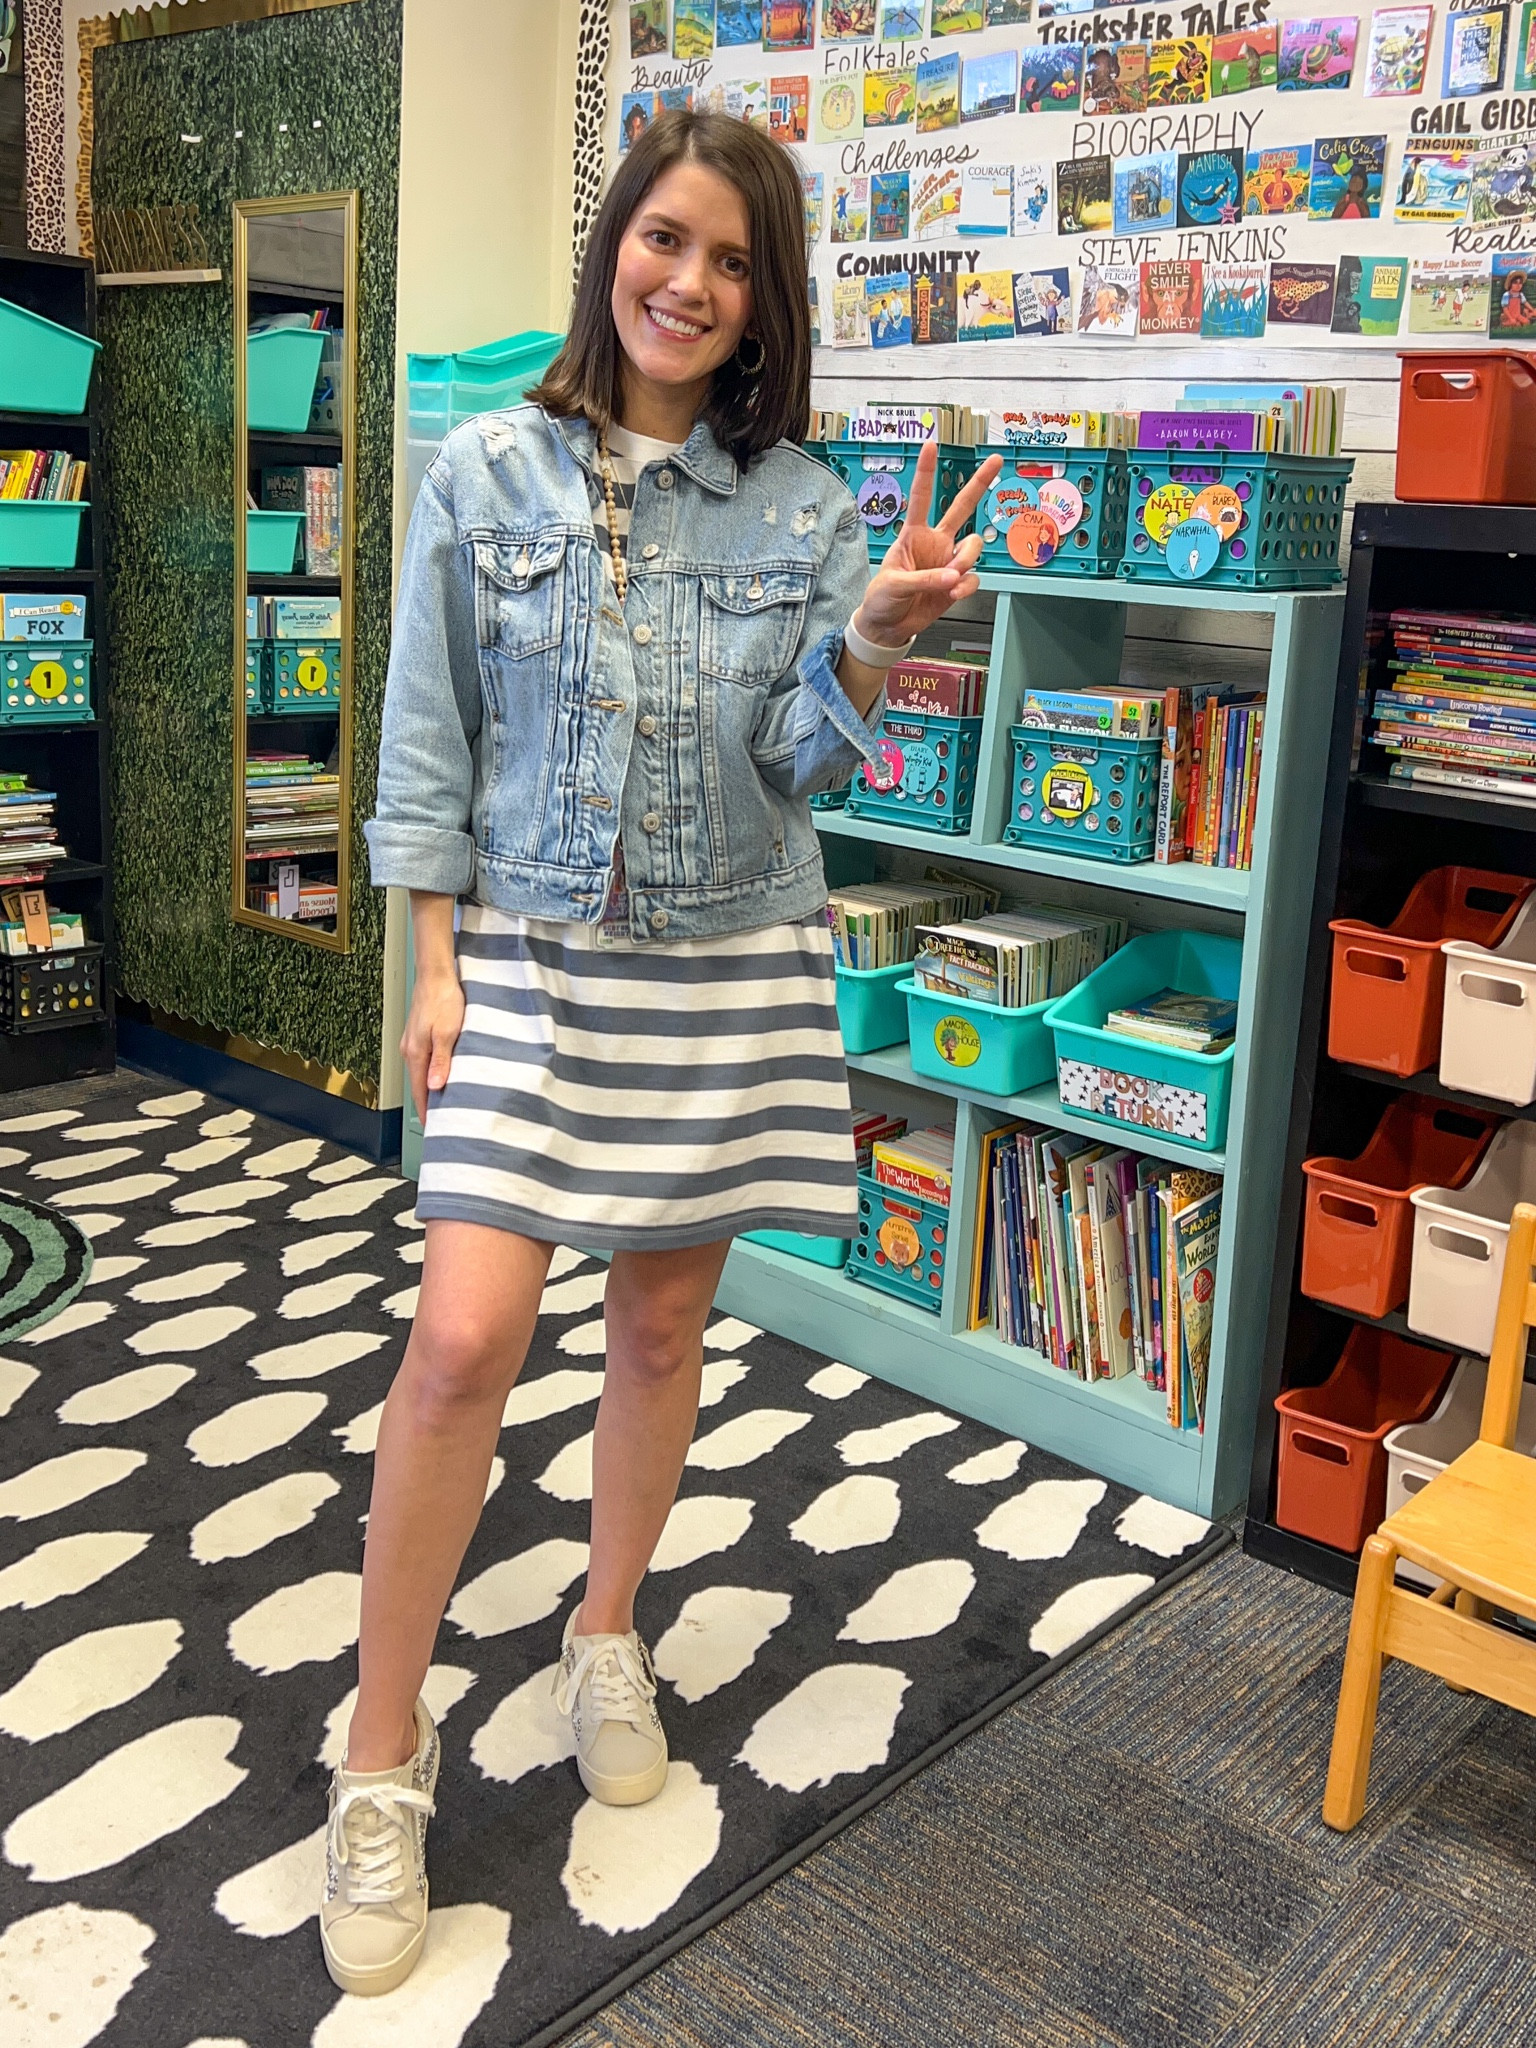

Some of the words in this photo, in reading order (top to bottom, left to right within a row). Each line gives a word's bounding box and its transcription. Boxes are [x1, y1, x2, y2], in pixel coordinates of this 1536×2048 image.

[1466, 29, 1488, 39] MISS
[631, 58, 713, 93] Beauty
[921, 62, 955, 79] TREASURE
[830, 76, 847, 84] EMPTY
[1410, 102, 1472, 133] GAIL
[1072, 109, 1264, 161] BIOGRAPHY
[1319, 139, 1347, 160] Celia
[1350, 138, 1377, 158] Cruz
[1406, 139, 1474, 151] PENGUINS
[1479, 136, 1513, 151] GIANT
[841, 139, 980, 175] Challenges
[1188, 152, 1232, 176] MANFISH
[968, 166, 1010, 176] COURAGE
[917, 169, 960, 210] COASTER
[1498, 218, 1522, 227] GIBBONS
[1079, 237, 1162, 267] STEVE
[1171, 225, 1288, 264] JENKINS
[836, 250, 981, 279] COMMUNITY
[1149, 263, 1191, 275] NEVER
[1422, 261, 1443, 270] Happy
[1444, 260, 1460, 268] Like
[1460, 259, 1483, 268] Soccer
[1104, 273, 1138, 281] FLIGHT
[1211, 268, 1222, 279] See
[1374, 275, 1399, 285] DADS
[1151, 276, 1190, 289] SMILE
[1162, 290, 1176, 302] AT
[1165, 304, 1174, 316] A
[1141, 318, 1195, 330] MONKEY
[1003, 412, 1027, 425] Ready,
[1041, 412, 1070, 427] Freddy!
[858, 419, 883, 437] BAD
[898, 420, 935, 439] KITTY
[1160, 429, 1189, 439] AARON
[1192, 428, 1233, 439] BLABEY
[1004, 428, 1068, 445] Super-Secret
[871, 475, 884, 484] BAD
[996, 488, 1028, 503] Ready,
[1158, 489, 1190, 497] big
[1039, 492, 1075, 519] RAINBOW
[1151, 498, 1195, 509] NATE
[1023, 514, 1043, 524] CAM
[1175, 526, 1211, 537] NARWHAL
[38, 606, 58, 614] Read!
[27, 620, 64, 635] FOX
[43, 671, 51, 689] 1
[899, 674, 940, 691] DIARY
[908, 690, 919, 703] of
[919, 695, 927, 704] a
[1052, 700, 1072, 708] LAGOON
[1450, 700, 1477, 711] Unicorn
[891, 724, 903, 733] THE
[1508, 724, 1526, 733] RESCUE
[1452, 732, 1474, 742] NANCY
[923, 757, 933, 767] Kid
[1158, 782, 1169, 818] REPORT
[1158, 821, 1167, 845] CARD
[25, 895, 40, 915] E
[946, 937, 966, 947] MAGIC
[934, 941, 954, 953] TREE
[954, 945, 977, 959] HOUSE
[949, 955, 964, 966] FACT
[964, 959, 990, 975] TRACKER
[957, 972, 996, 990] Vikings
[943, 1019, 969, 1032] MAGIC
[957, 1036, 981, 1048] HOUSE
[1099, 1069, 1164, 1102] BOOK
[1090, 1089, 1175, 1132] RETURN
[881, 1163, 895, 1177] The
[894, 1172, 920, 1188] World
[921, 1187, 942, 1200] according
[885, 1221, 915, 1236] Humphrey
[1188, 1210, 1218, 1235] Magic
[891, 1232, 910, 1243] Series
[1092, 1236, 1100, 1268] America
[1187, 1244, 1216, 1267] WORLD
